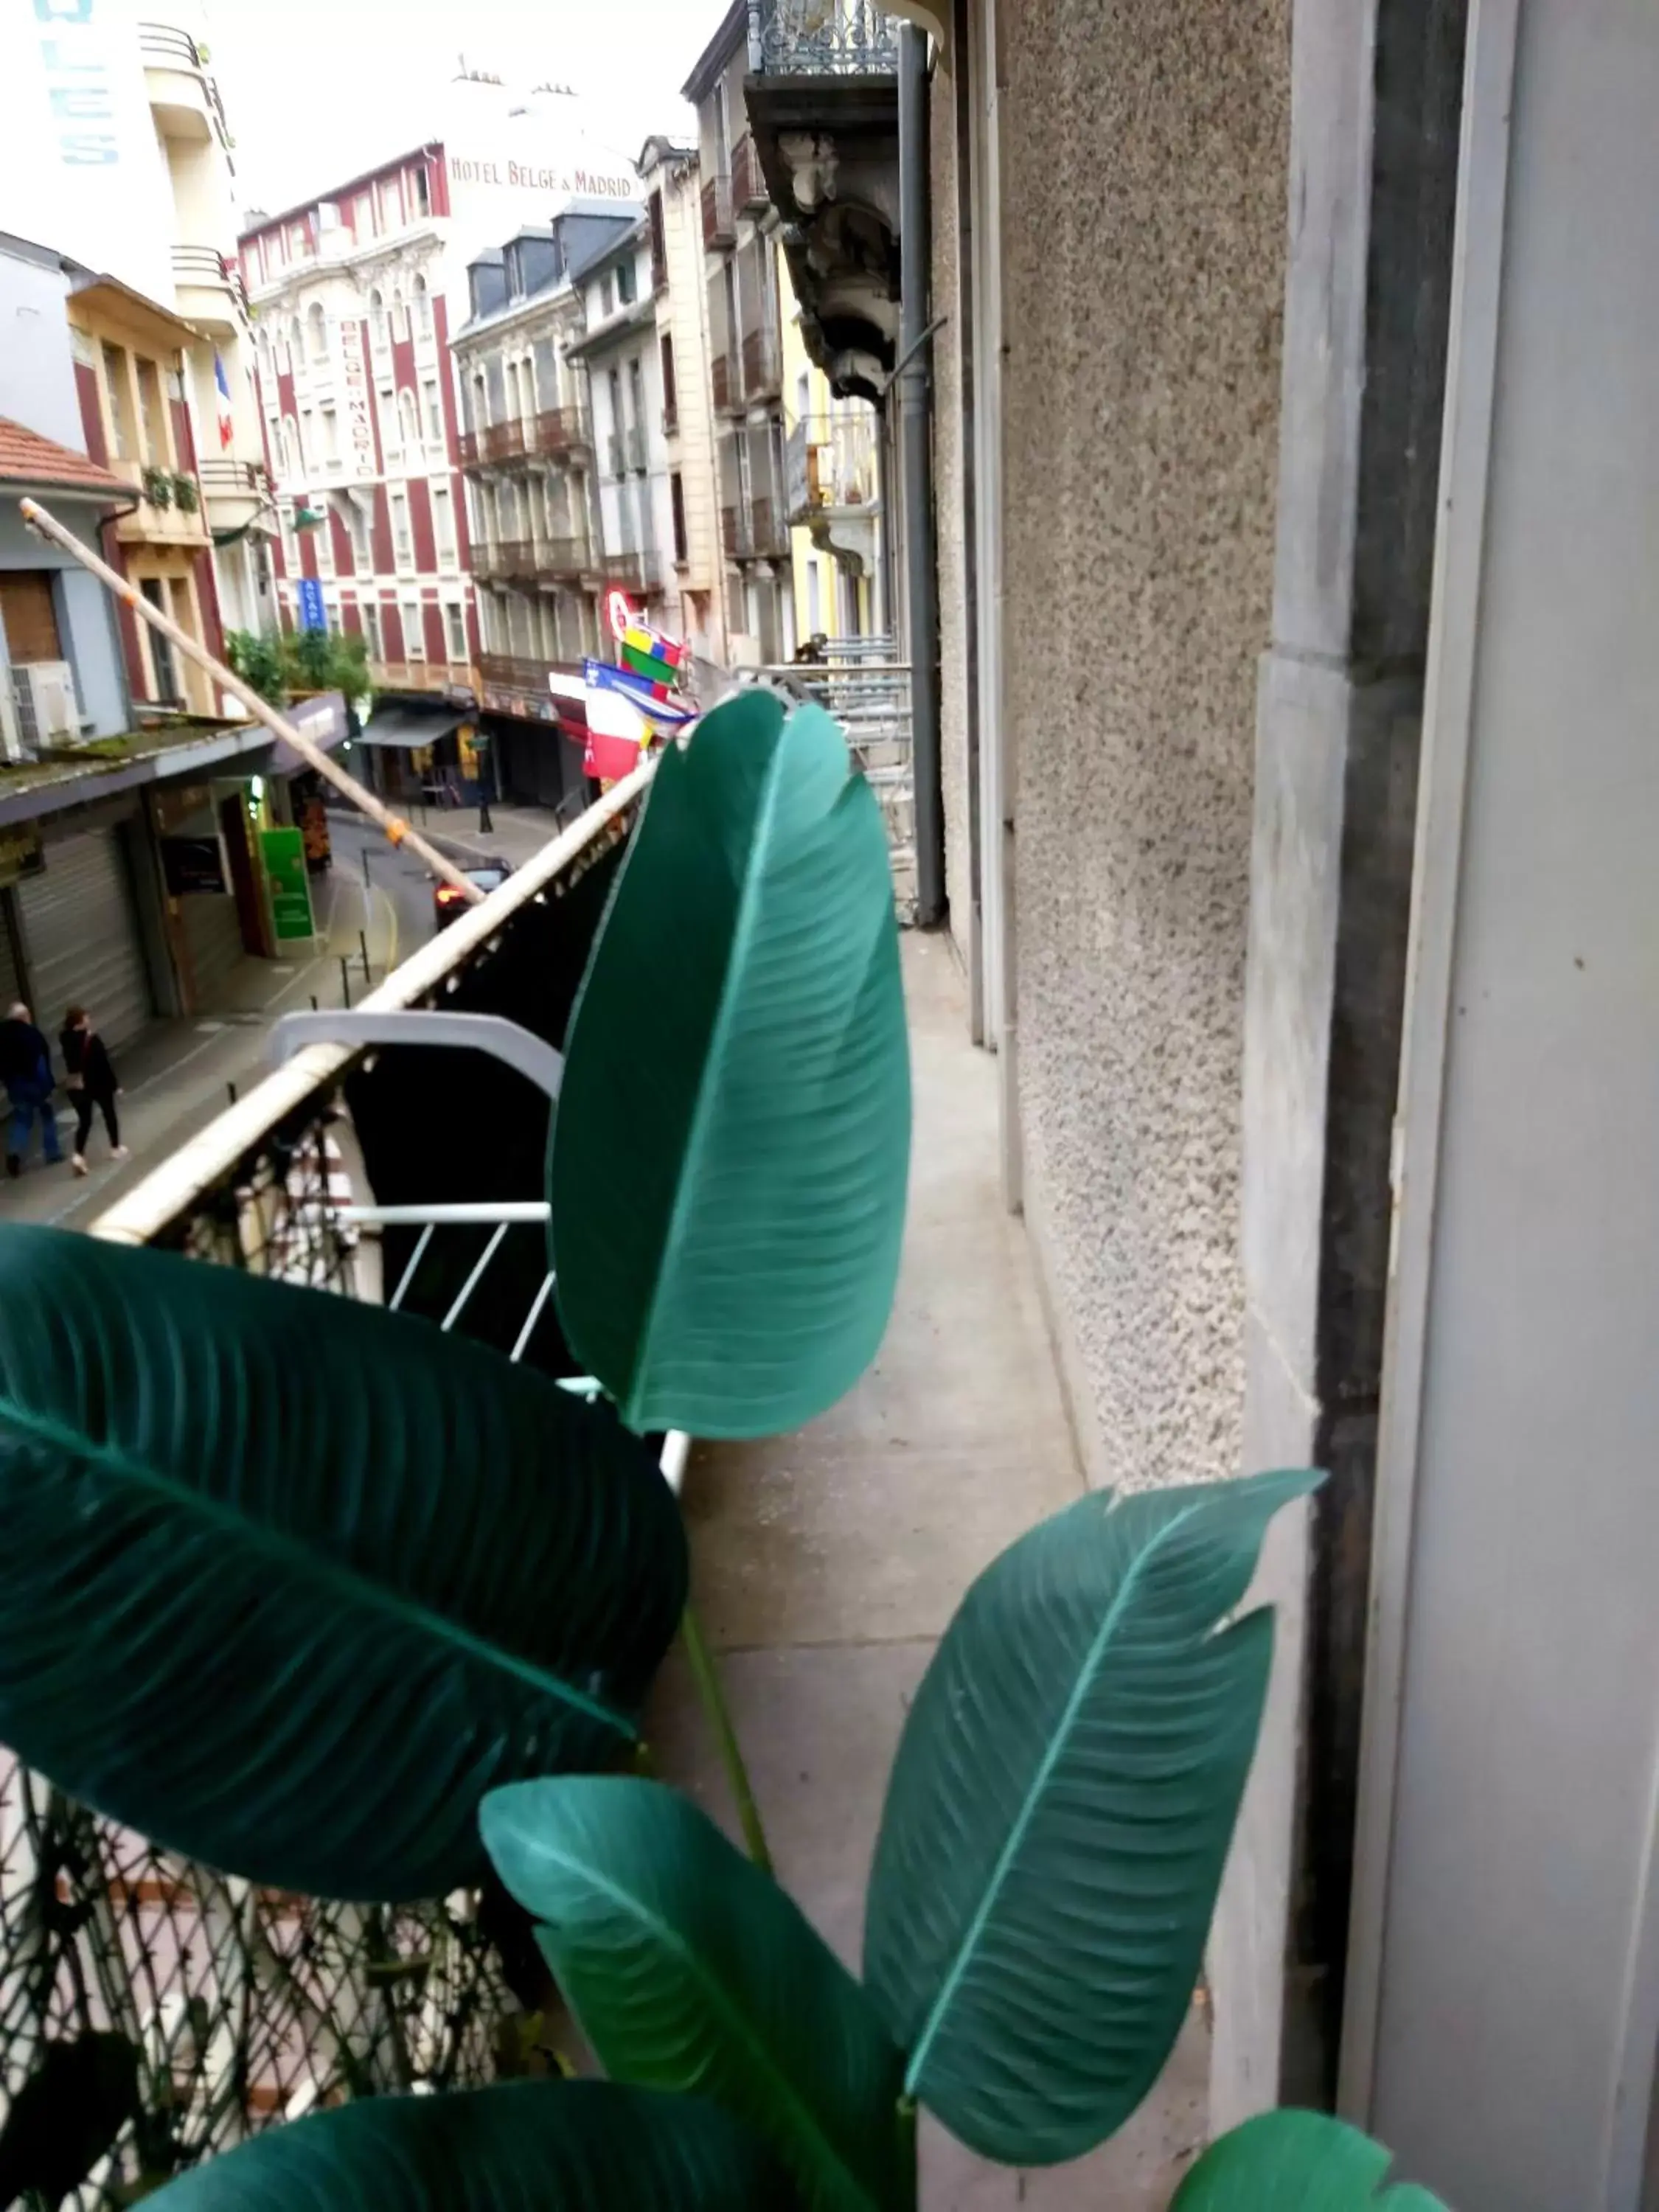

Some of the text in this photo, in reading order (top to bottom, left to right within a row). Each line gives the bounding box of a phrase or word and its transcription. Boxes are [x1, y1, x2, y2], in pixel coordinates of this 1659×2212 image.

[451, 156, 502, 185] HOTEL
[508, 160, 556, 189] BELGE
[574, 169, 631, 198] MADRID
